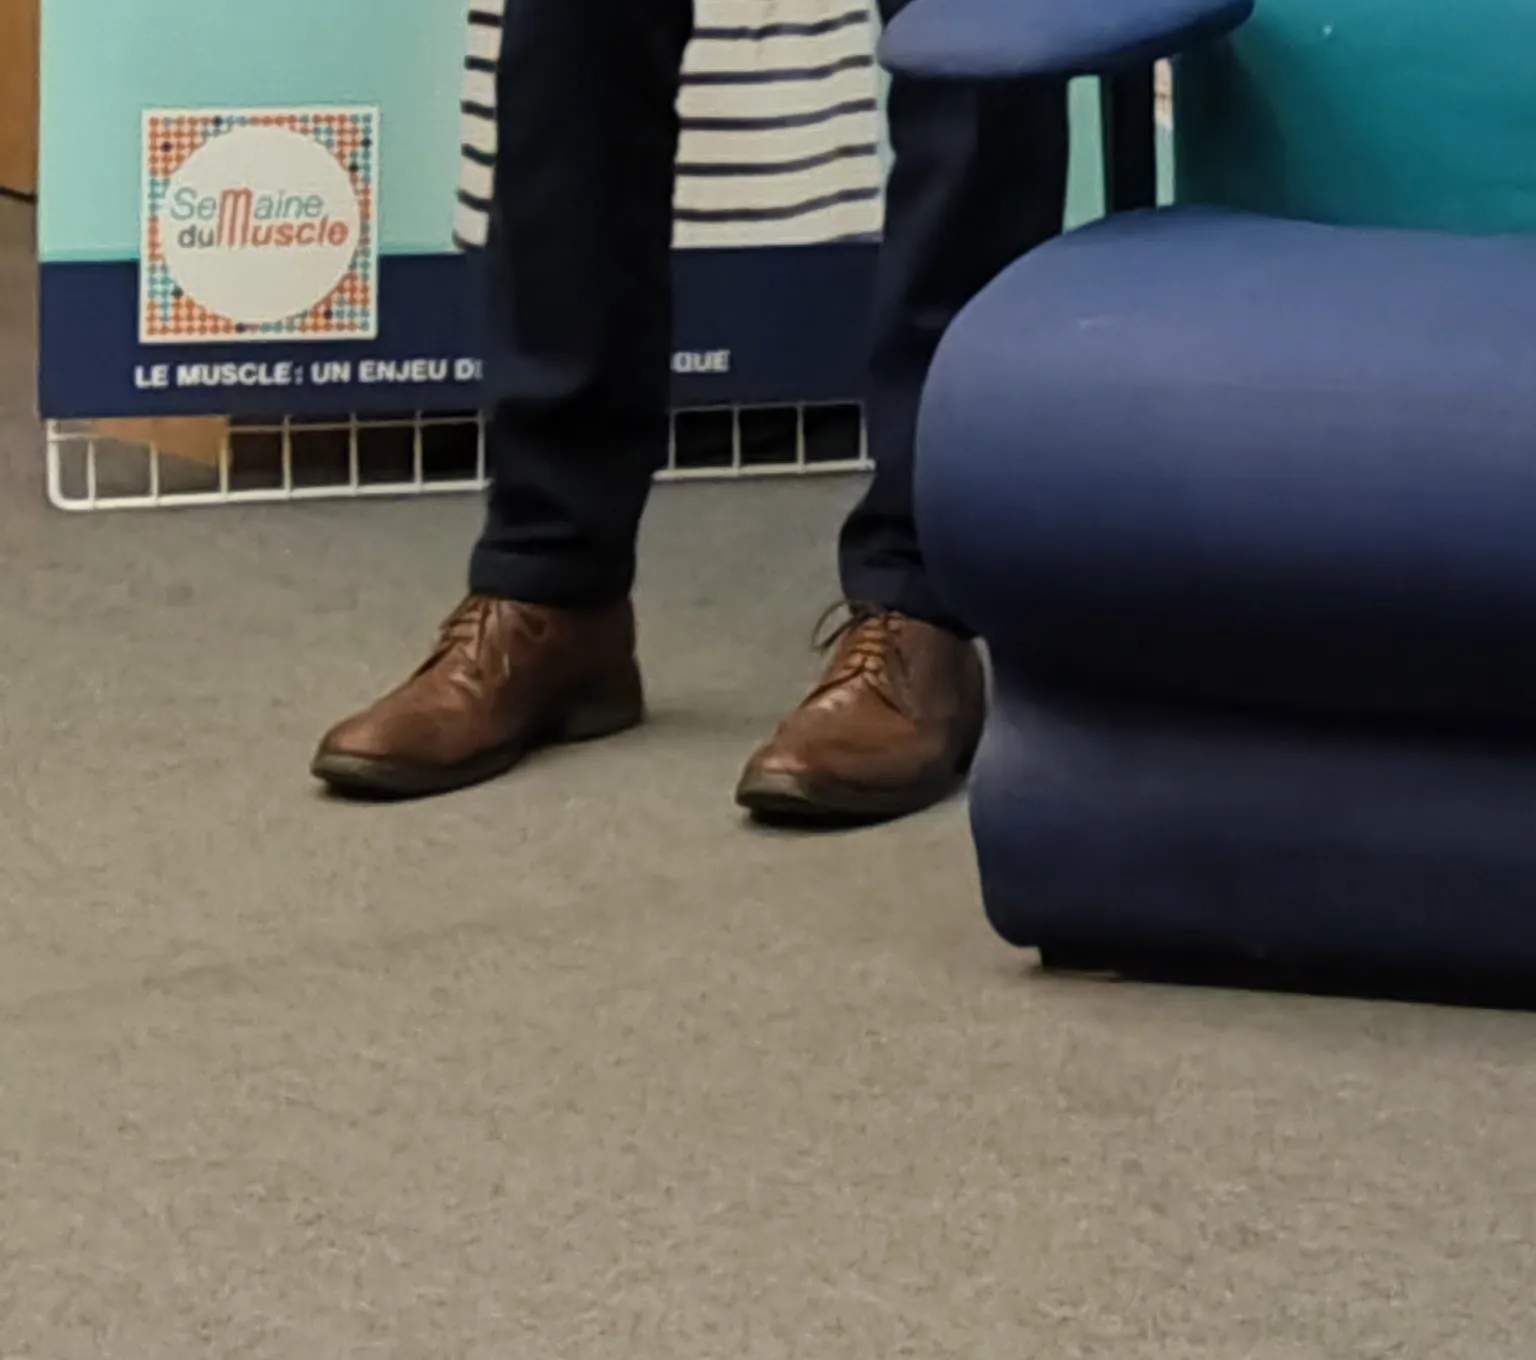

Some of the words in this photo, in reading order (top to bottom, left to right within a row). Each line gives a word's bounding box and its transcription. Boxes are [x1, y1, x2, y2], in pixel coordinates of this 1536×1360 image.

[177, 224, 215, 249] du
[134, 365, 169, 389] LE
[311, 360, 351, 385] UN
[358, 358, 449, 384] ENJEU
[670, 348, 732, 373] QUE
